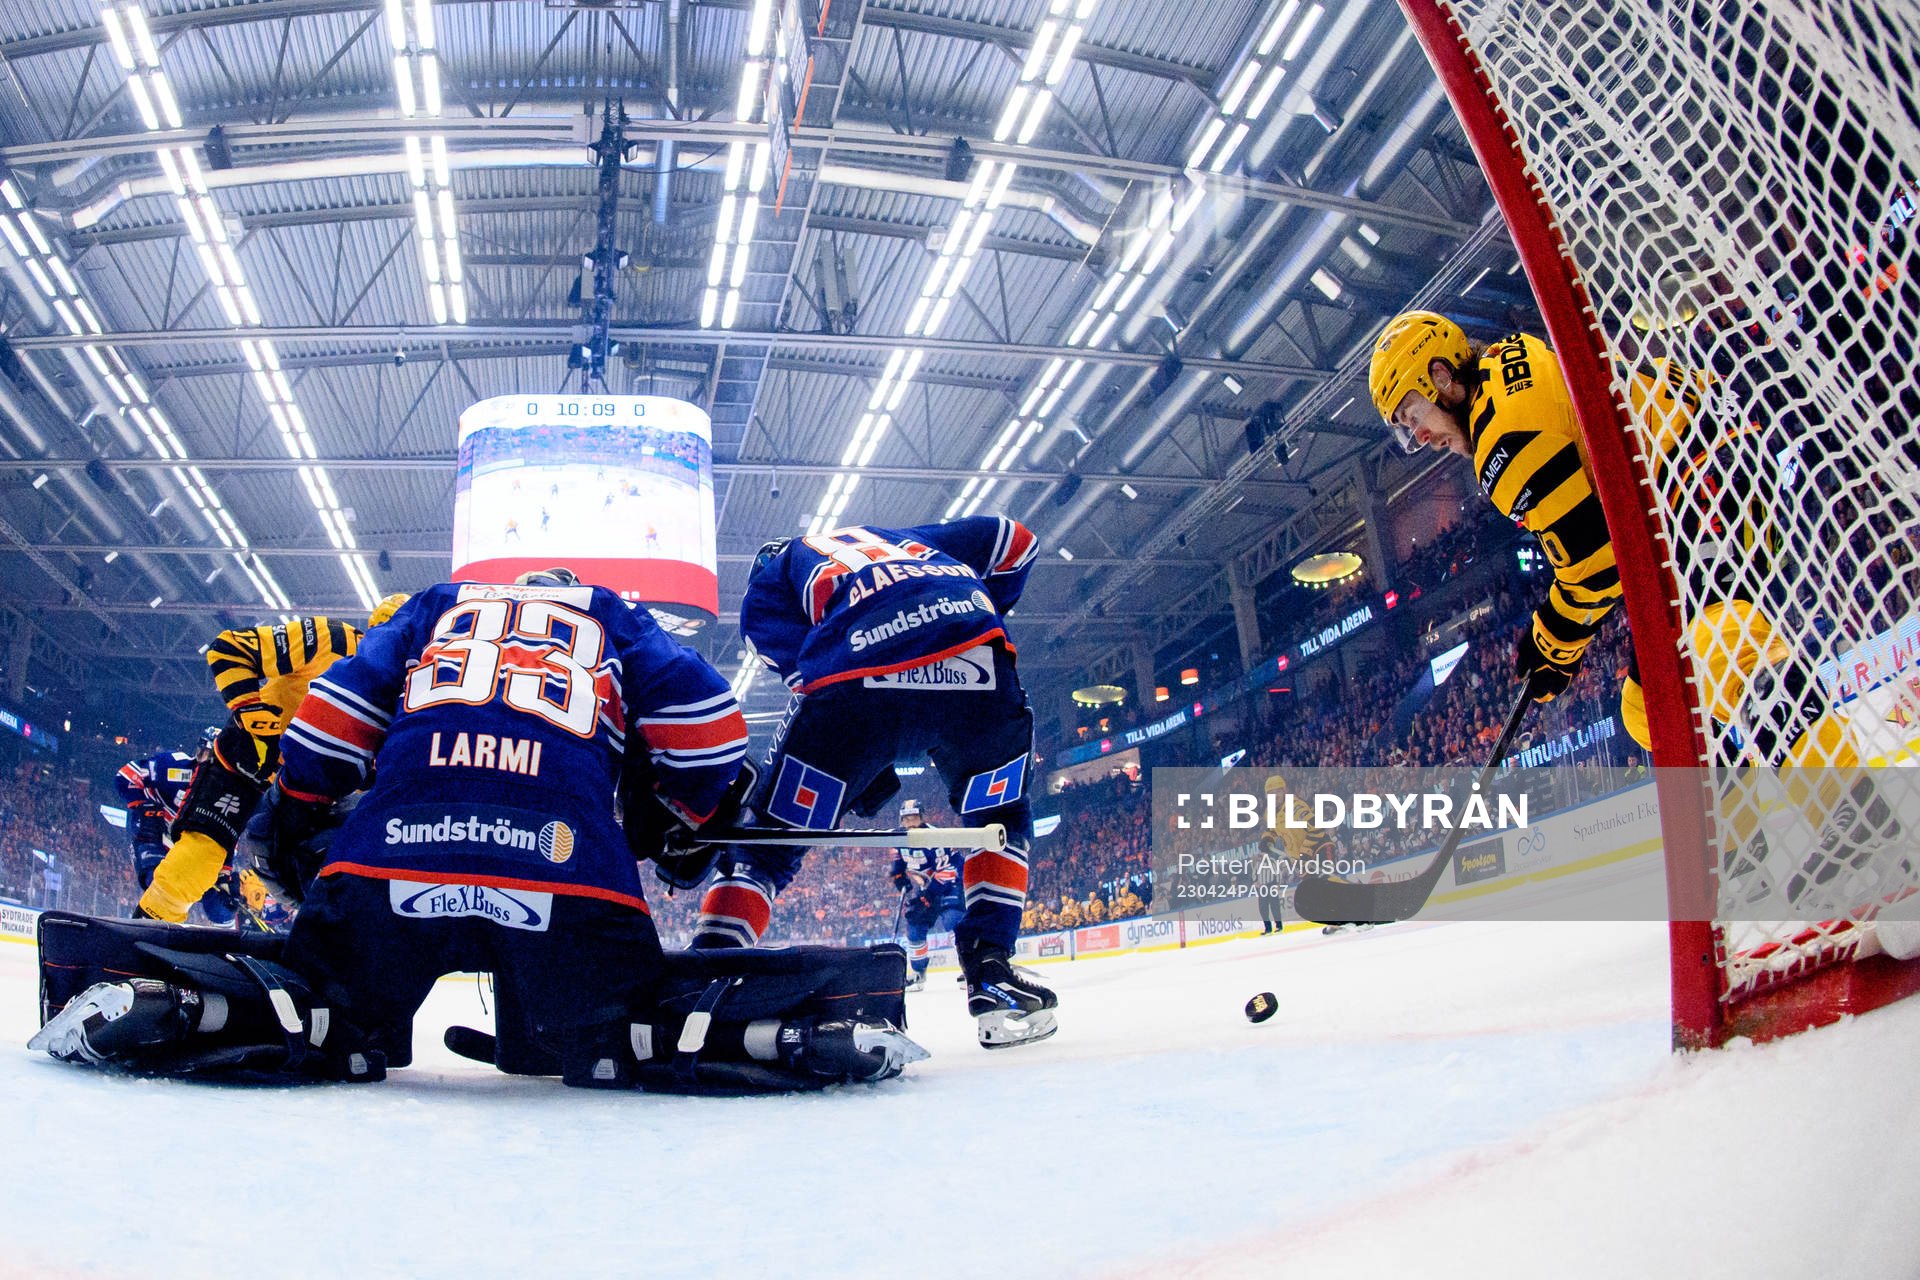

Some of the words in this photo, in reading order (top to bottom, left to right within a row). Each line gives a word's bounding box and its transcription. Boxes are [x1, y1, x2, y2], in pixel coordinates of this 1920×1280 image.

[527, 402, 538, 416] 0
[557, 402, 616, 417] 10:09
[634, 403, 645, 417] 0
[849, 562, 978, 607] CLAESSON
[849, 597, 974, 652] Sundström
[1300, 637, 1320, 657] TILL
[1319, 623, 1341, 646] VIDA
[1341, 605, 1373, 635] ARENA
[403, 599, 604, 740] 33
[1125, 729, 1146, 744] TILL
[1145, 721, 1166, 738] VIDA
[429, 731, 543, 777] LARMI
[385, 815, 536, 851] Sundström
[1573, 811, 1635, 841] Sparbanken
[430, 884, 511, 922] FleXBuss
[1127, 920, 1173, 944] dynacon
[987, 985, 1017, 1006] CCM
